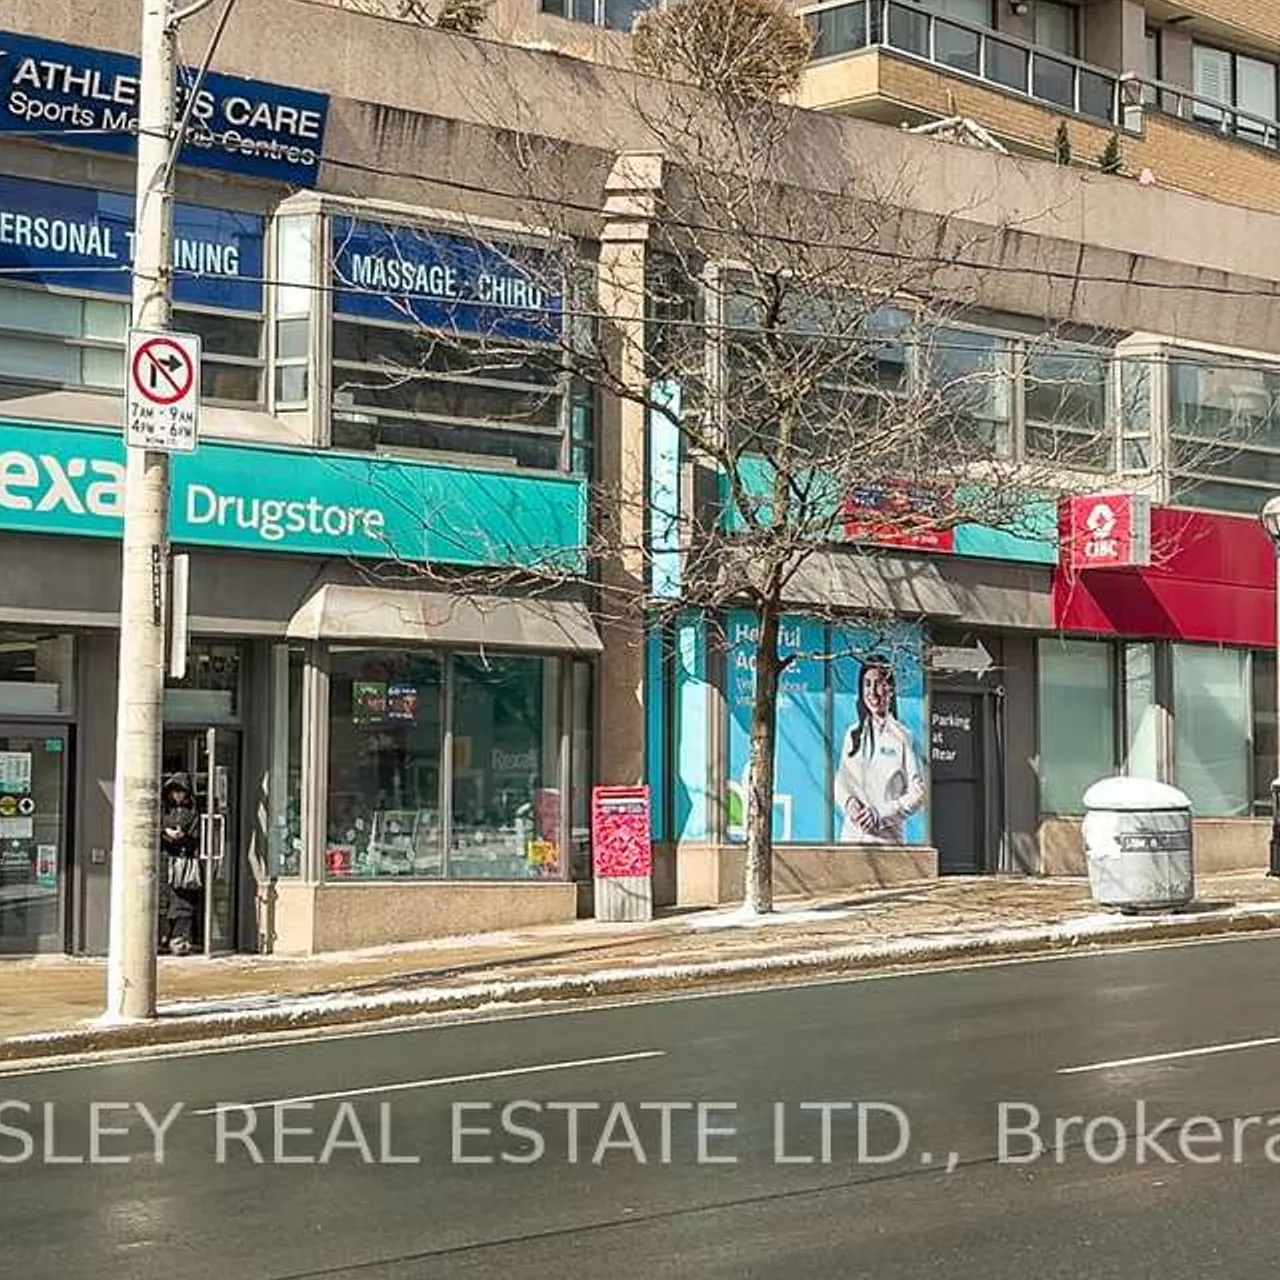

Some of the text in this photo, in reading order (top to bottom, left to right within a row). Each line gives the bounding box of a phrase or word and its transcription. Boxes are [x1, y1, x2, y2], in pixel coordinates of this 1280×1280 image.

[9, 91, 95, 128] Sports
[222, 130, 316, 166] Centres
[225, 96, 321, 139] CARE
[125, 231, 240, 276] TINING
[352, 254, 543, 309] MASSAGE CHIRO
[187, 483, 385, 539] Drugstore
[1084, 539, 1118, 558] CIBC
[931, 713, 971, 731] Parking
[931, 747, 957, 761] Rear
